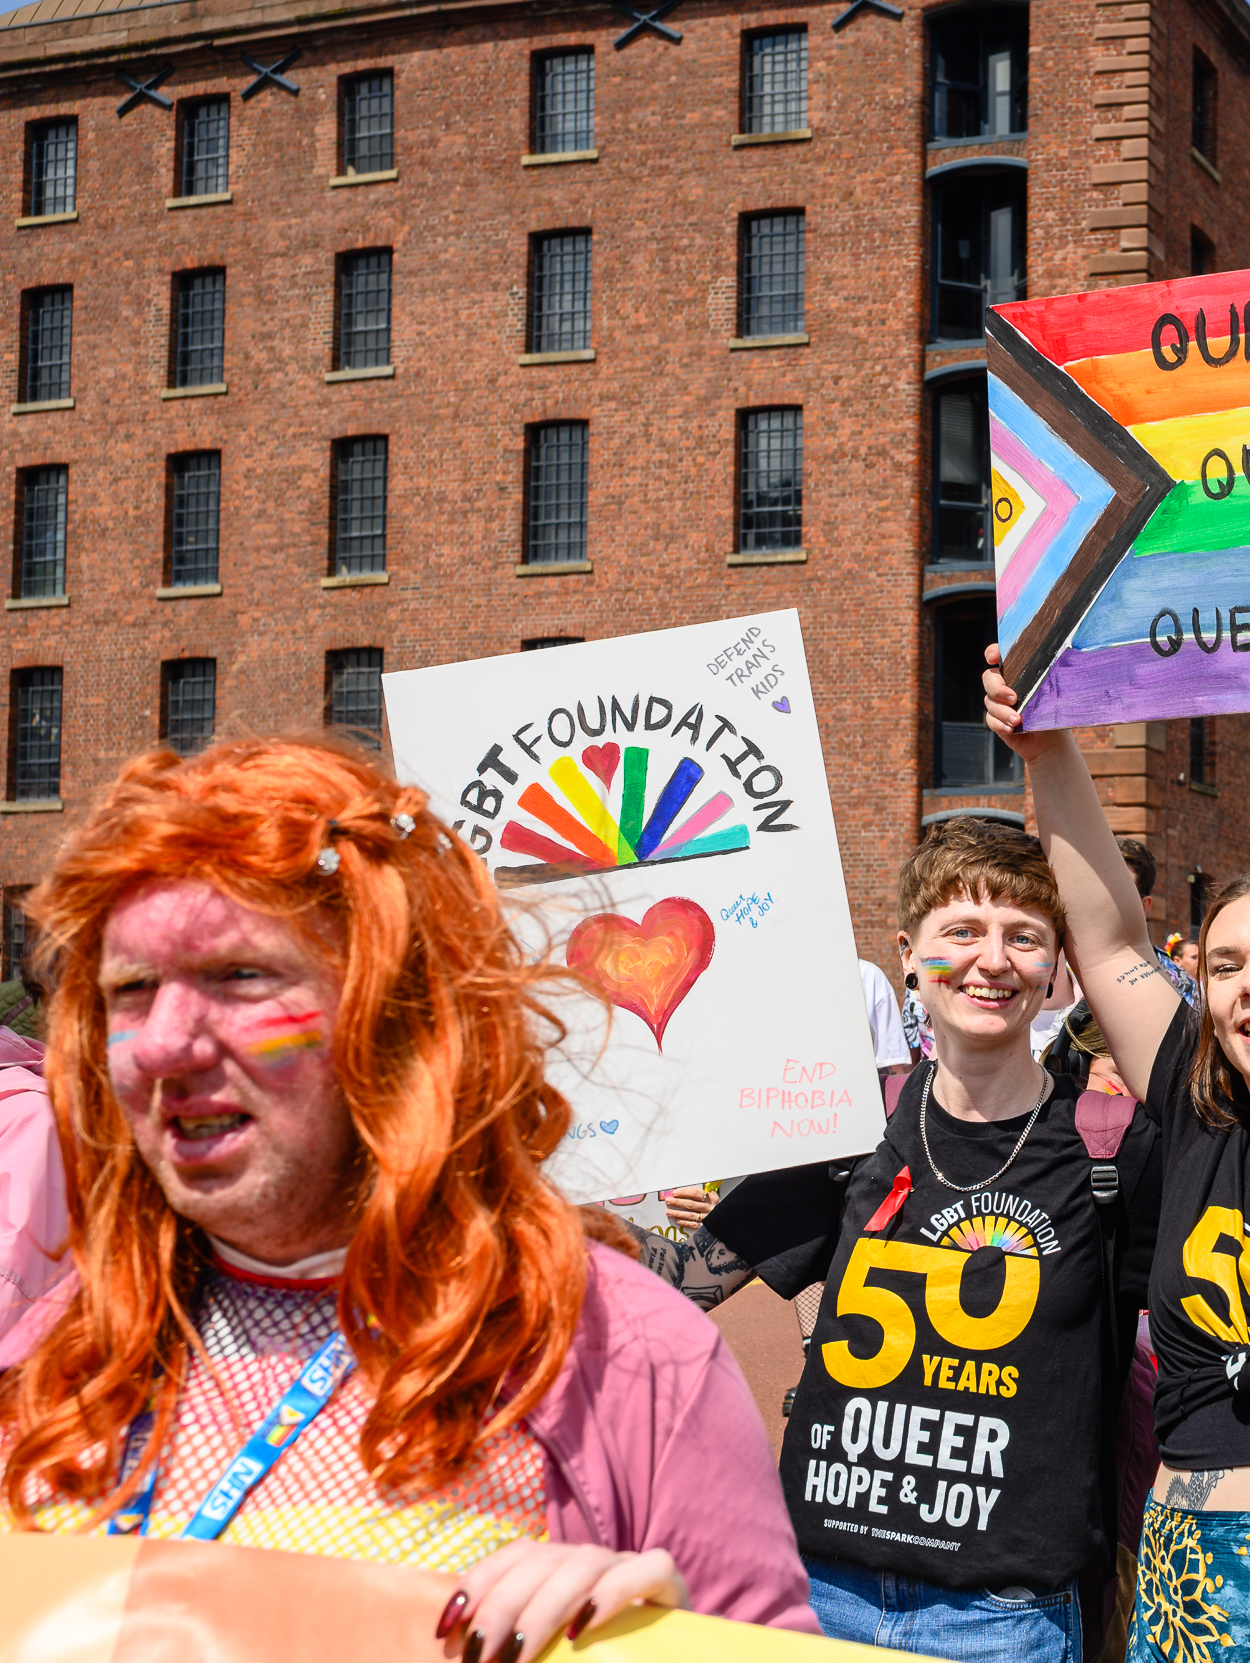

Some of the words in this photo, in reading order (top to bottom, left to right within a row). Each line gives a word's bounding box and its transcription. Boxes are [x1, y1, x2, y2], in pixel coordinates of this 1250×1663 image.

[707, 627, 761, 675] DEFEND
[725, 639, 776, 687] TRANS
[751, 664, 785, 700] KIDS
[449, 743, 519, 861] GBT
[513, 692, 802, 832] FOUNDATION
[735, 892, 760, 925] HOPE
[758, 892, 774, 917] JOY
[782, 1058, 837, 1084] END
[739, 1087, 853, 1110] BIPHOBIA
[770, 1112, 838, 1139] NOW!
[920, 1200, 967, 1243] LGBT
[970, 1191, 1062, 1257] FOUNDATION
[821, 1237, 1041, 1389] 50
[921, 1354, 1020, 1398] YEARS
[810, 1423, 835, 1451] OF
[841, 1396, 1011, 1479] QUEER
[207, 1460, 257, 1519] NHS
[804, 1458, 894, 1515] HOPE
[899, 1475, 918, 1505] &
[920, 1479, 1002, 1531] JOY
[823, 1518, 859, 1533] SUPPORTED
[860, 1525, 869, 1535] BY
